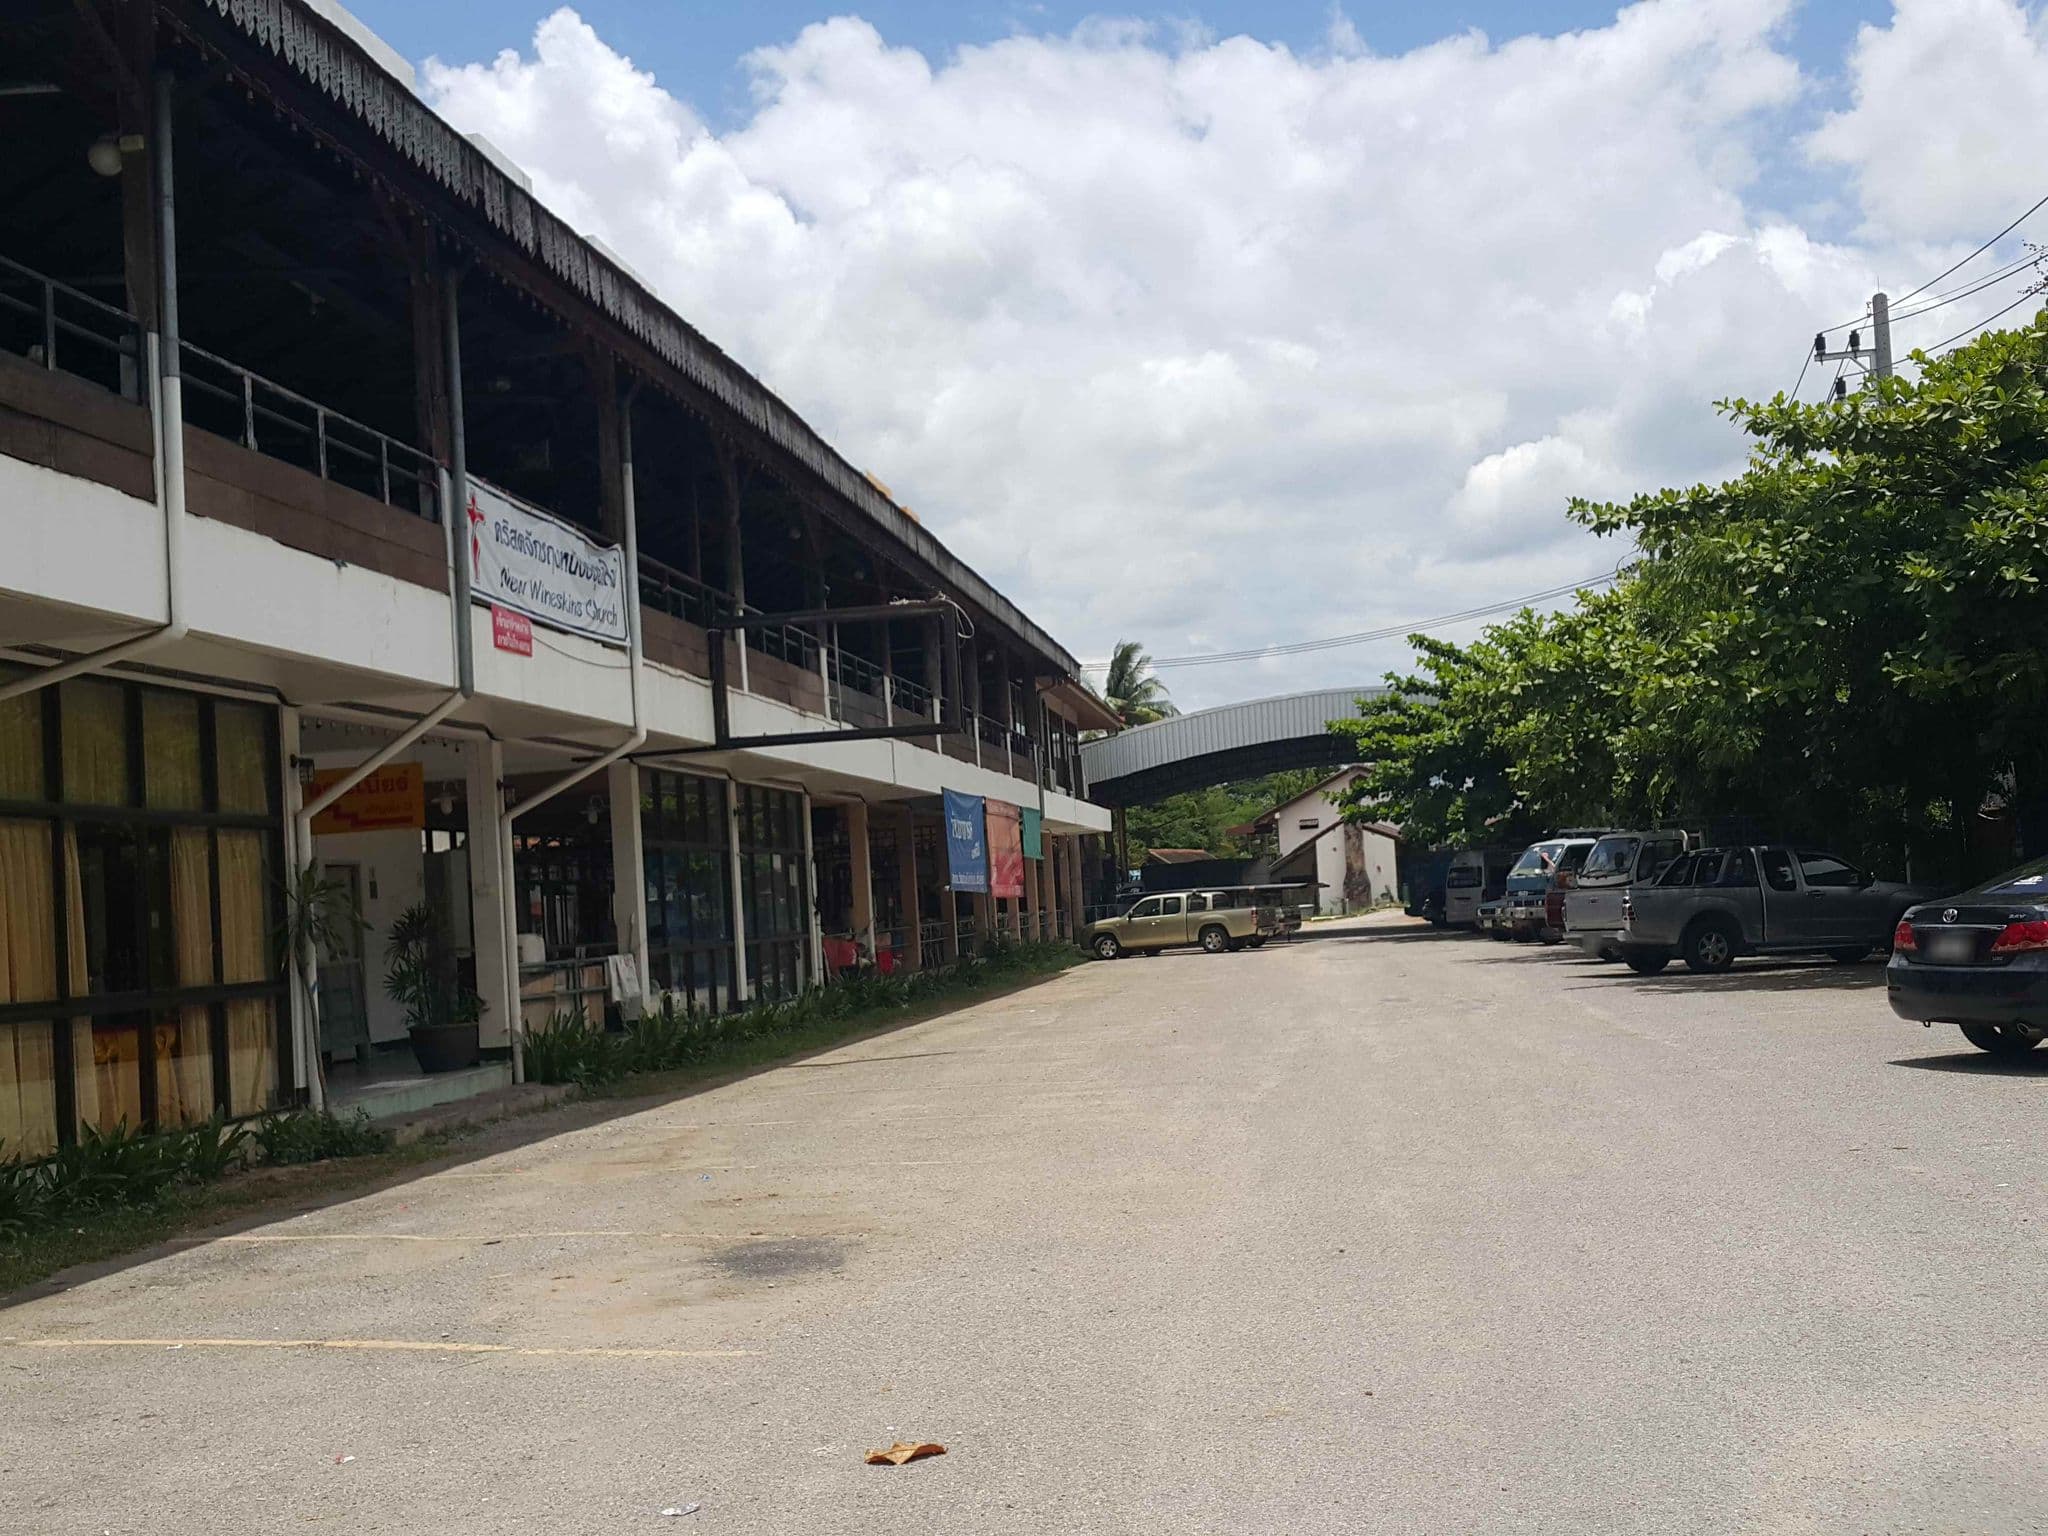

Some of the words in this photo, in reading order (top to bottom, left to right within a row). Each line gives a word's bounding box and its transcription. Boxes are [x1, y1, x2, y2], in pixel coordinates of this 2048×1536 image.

[500, 567, 527, 594] New
[530, 580, 582, 617] Wineskins
[586, 600, 617, 626] Church
